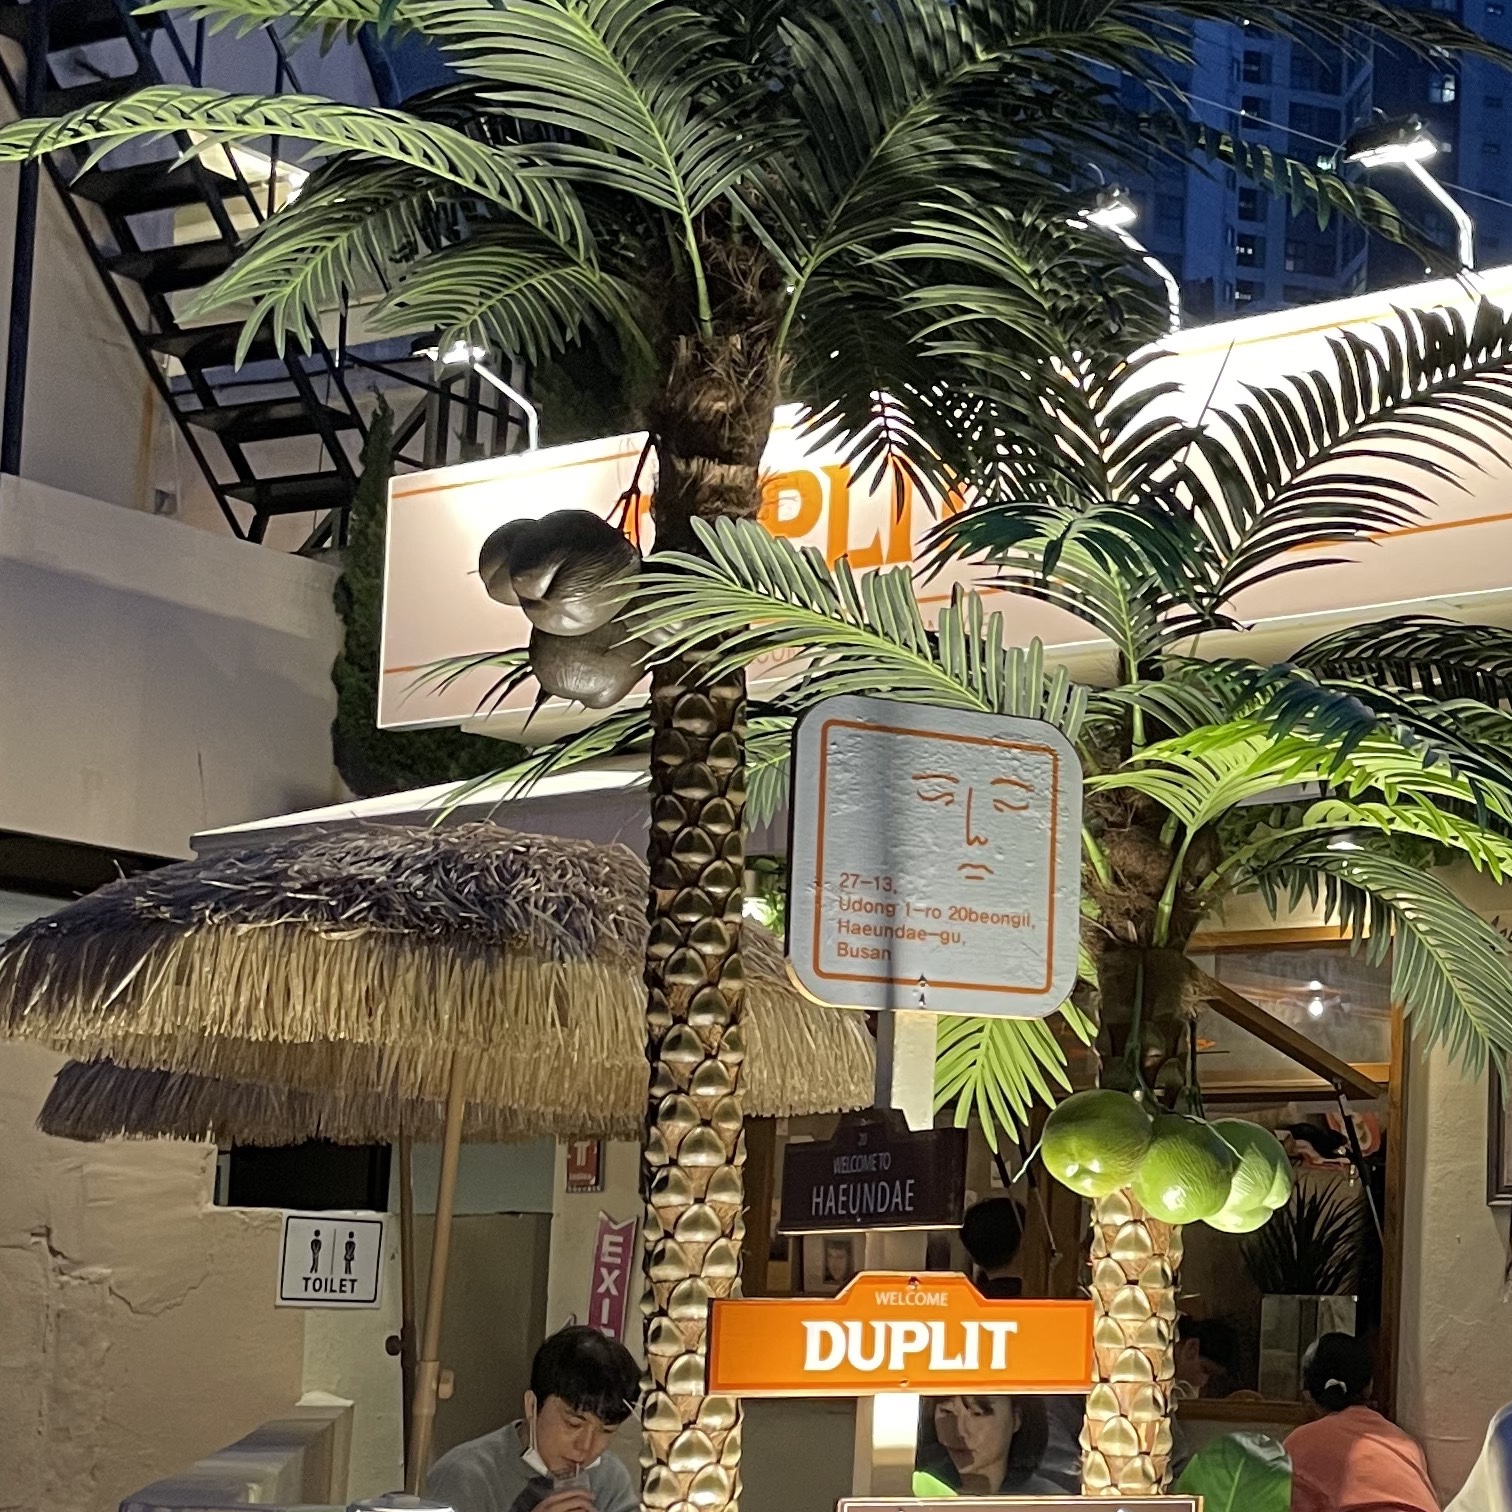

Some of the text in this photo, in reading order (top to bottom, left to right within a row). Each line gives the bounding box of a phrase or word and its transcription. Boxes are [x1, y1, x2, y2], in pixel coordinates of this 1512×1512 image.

[839, 872, 898, 894] 27-13,
[838, 895, 1036, 930] Udong 1-ro 20beongil,
[837, 919, 966, 946] Haeundae-gu,
[837, 941, 892, 961] Busan
[833, 1152, 892, 1174] WELCOME TO
[811, 1179, 915, 1216] HAEUNDAE
[302, 1277, 358, 1295] TOILET
[874, 1291, 949, 1307] WELCOME
[801, 1320, 1018, 1371] DUPLIT
